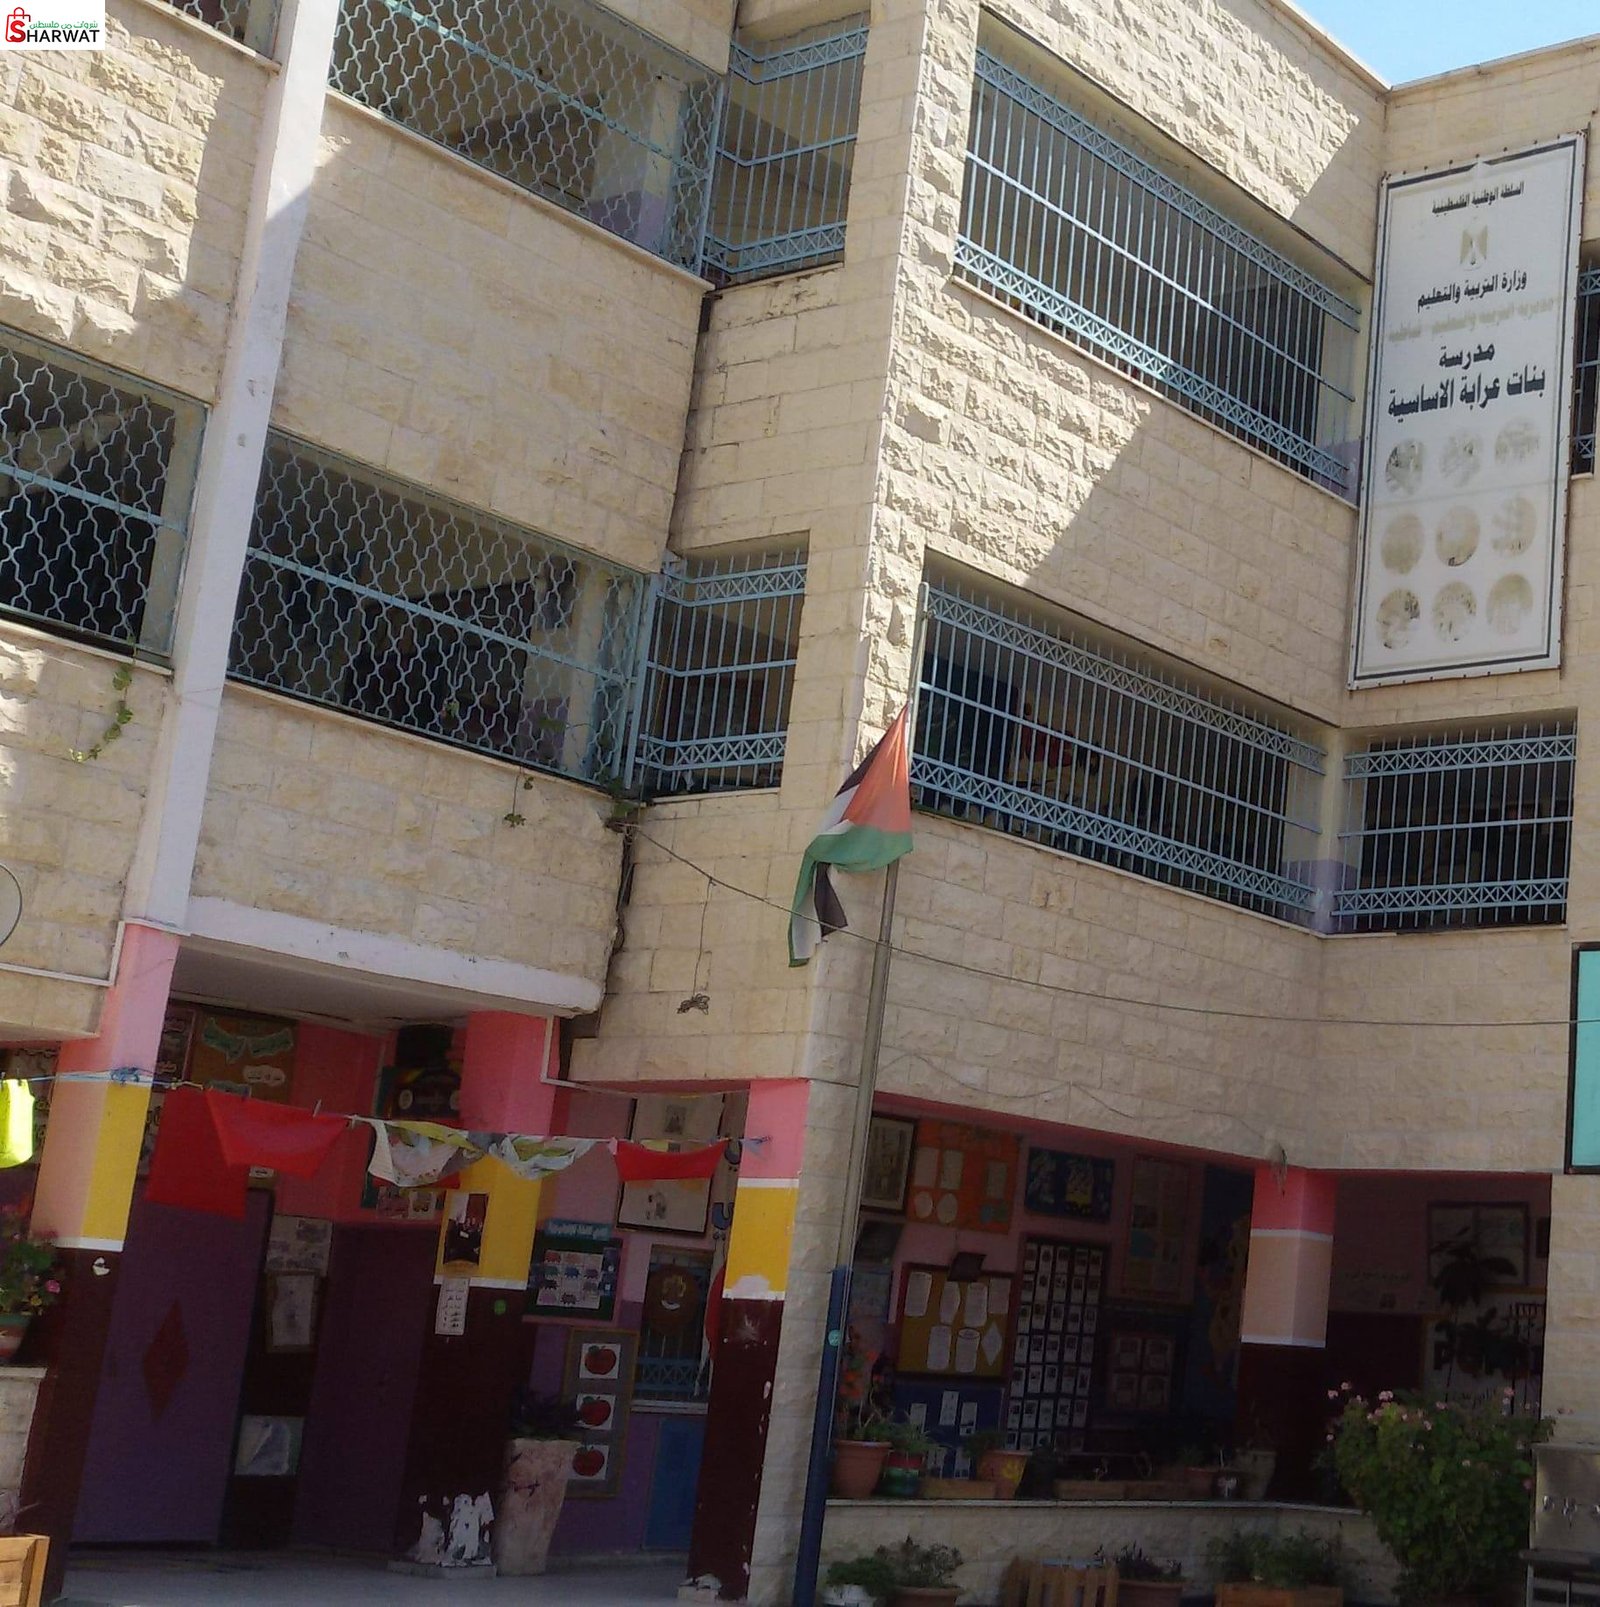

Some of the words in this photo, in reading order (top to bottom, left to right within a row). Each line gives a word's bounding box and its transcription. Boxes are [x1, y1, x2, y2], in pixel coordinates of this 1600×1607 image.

[1464, 274, 1499, 301] التربية
[1501, 269, 1528, 293] وزارة
[1417, 283, 1462, 313] والتعليم
[1439, 343, 1496, 370] مدرسة
[1459, 372, 1500, 411] عرابة
[1506, 364, 1546, 399] بنات
[1388, 377, 1455, 424] الاساسية
